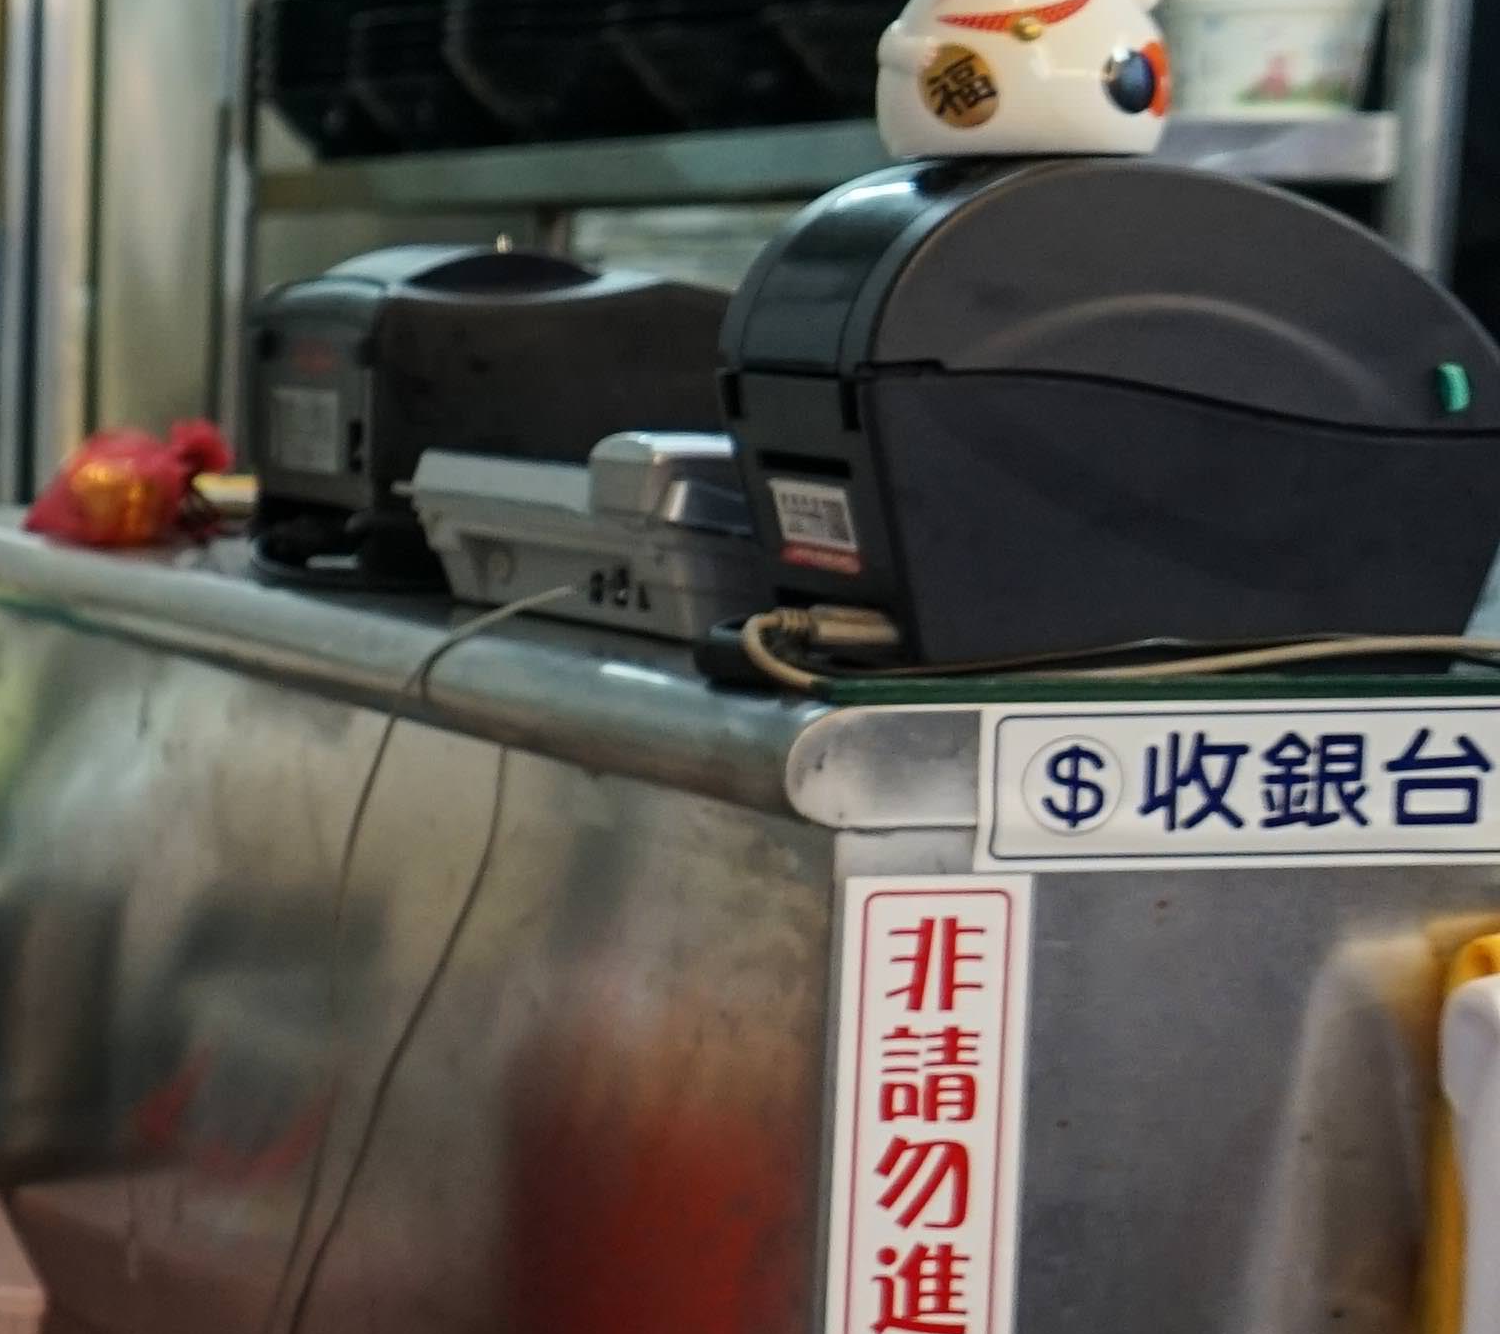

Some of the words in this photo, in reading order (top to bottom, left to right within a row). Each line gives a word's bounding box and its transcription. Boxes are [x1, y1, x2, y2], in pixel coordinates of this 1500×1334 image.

[926, 54, 998, 118] 福
[1137, 729, 1493, 831] 收銀台
